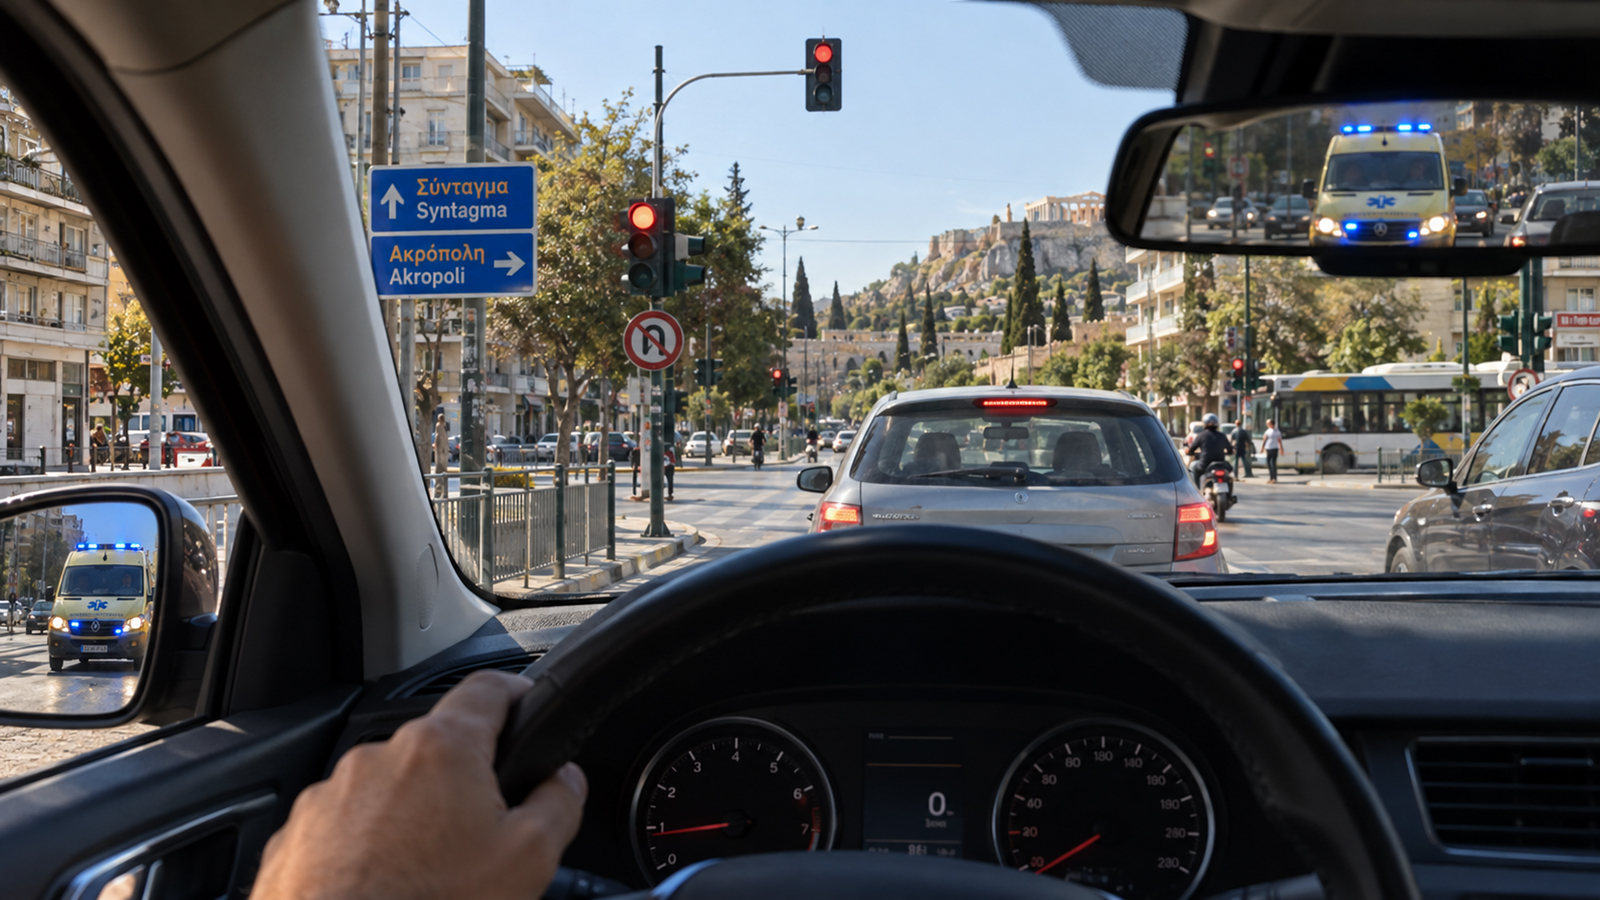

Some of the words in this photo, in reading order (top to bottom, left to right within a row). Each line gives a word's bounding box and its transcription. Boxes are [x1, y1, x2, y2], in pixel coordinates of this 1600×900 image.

[416, 177, 509, 199] Σύνταγμα
[416, 201, 508, 224] Syntagma
[389, 243, 485, 267] Ακρόπολη
[389, 266, 465, 289] Akropoli
[731, 751, 740, 761] 4
[693, 761, 702, 773] 3
[769, 762, 779, 774] 5
[667, 786, 676, 799] 2
[793, 788, 803, 800] 6
[928, 791, 946, 817] 0
[659, 821, 666, 833] 1
[801, 823, 810, 835] 7
[667, 853, 677, 865] 0
